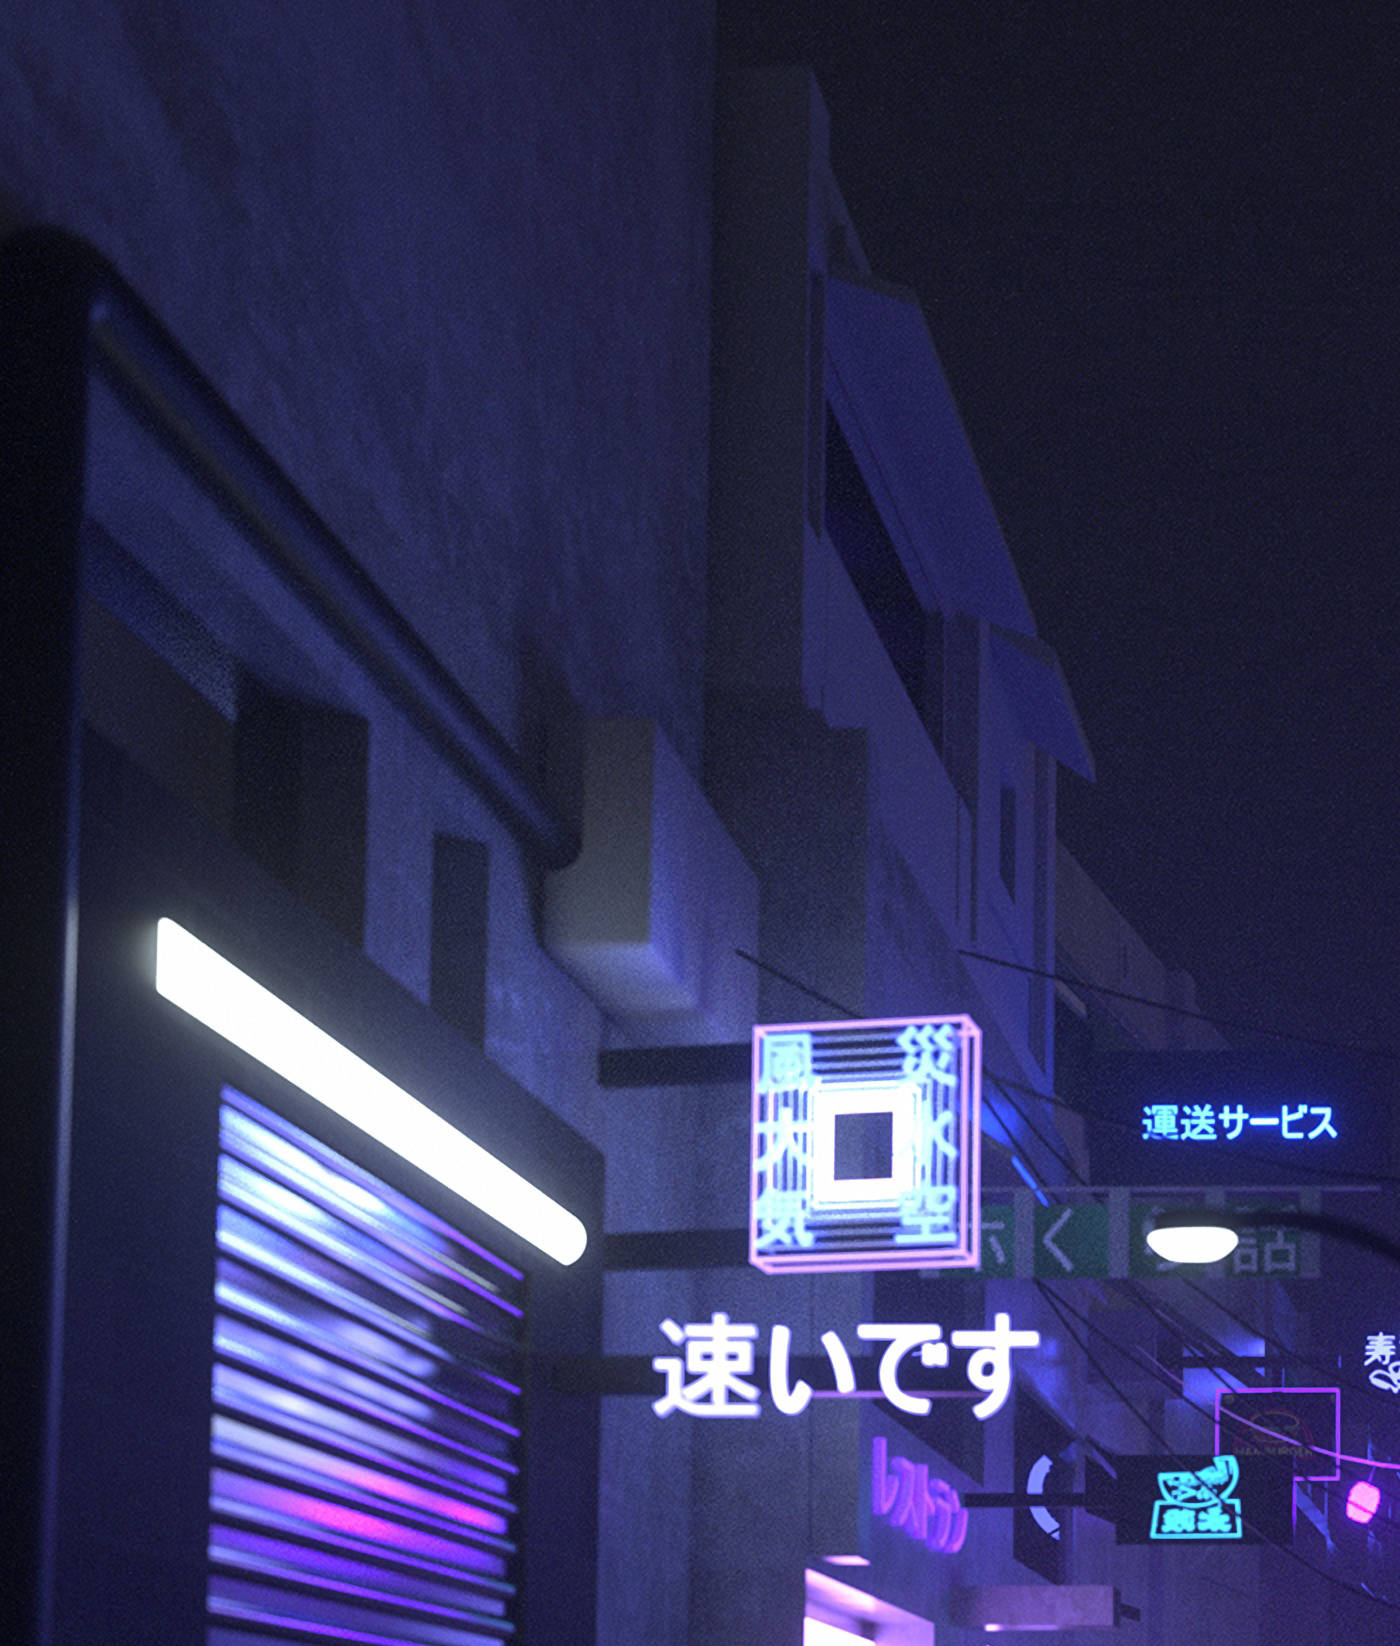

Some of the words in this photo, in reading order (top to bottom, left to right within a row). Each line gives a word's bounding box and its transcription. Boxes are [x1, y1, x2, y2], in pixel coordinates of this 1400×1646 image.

[1141, 1103, 1339, 1141] 運送サービス
[651, 1311, 1041, 1421] 速いです
